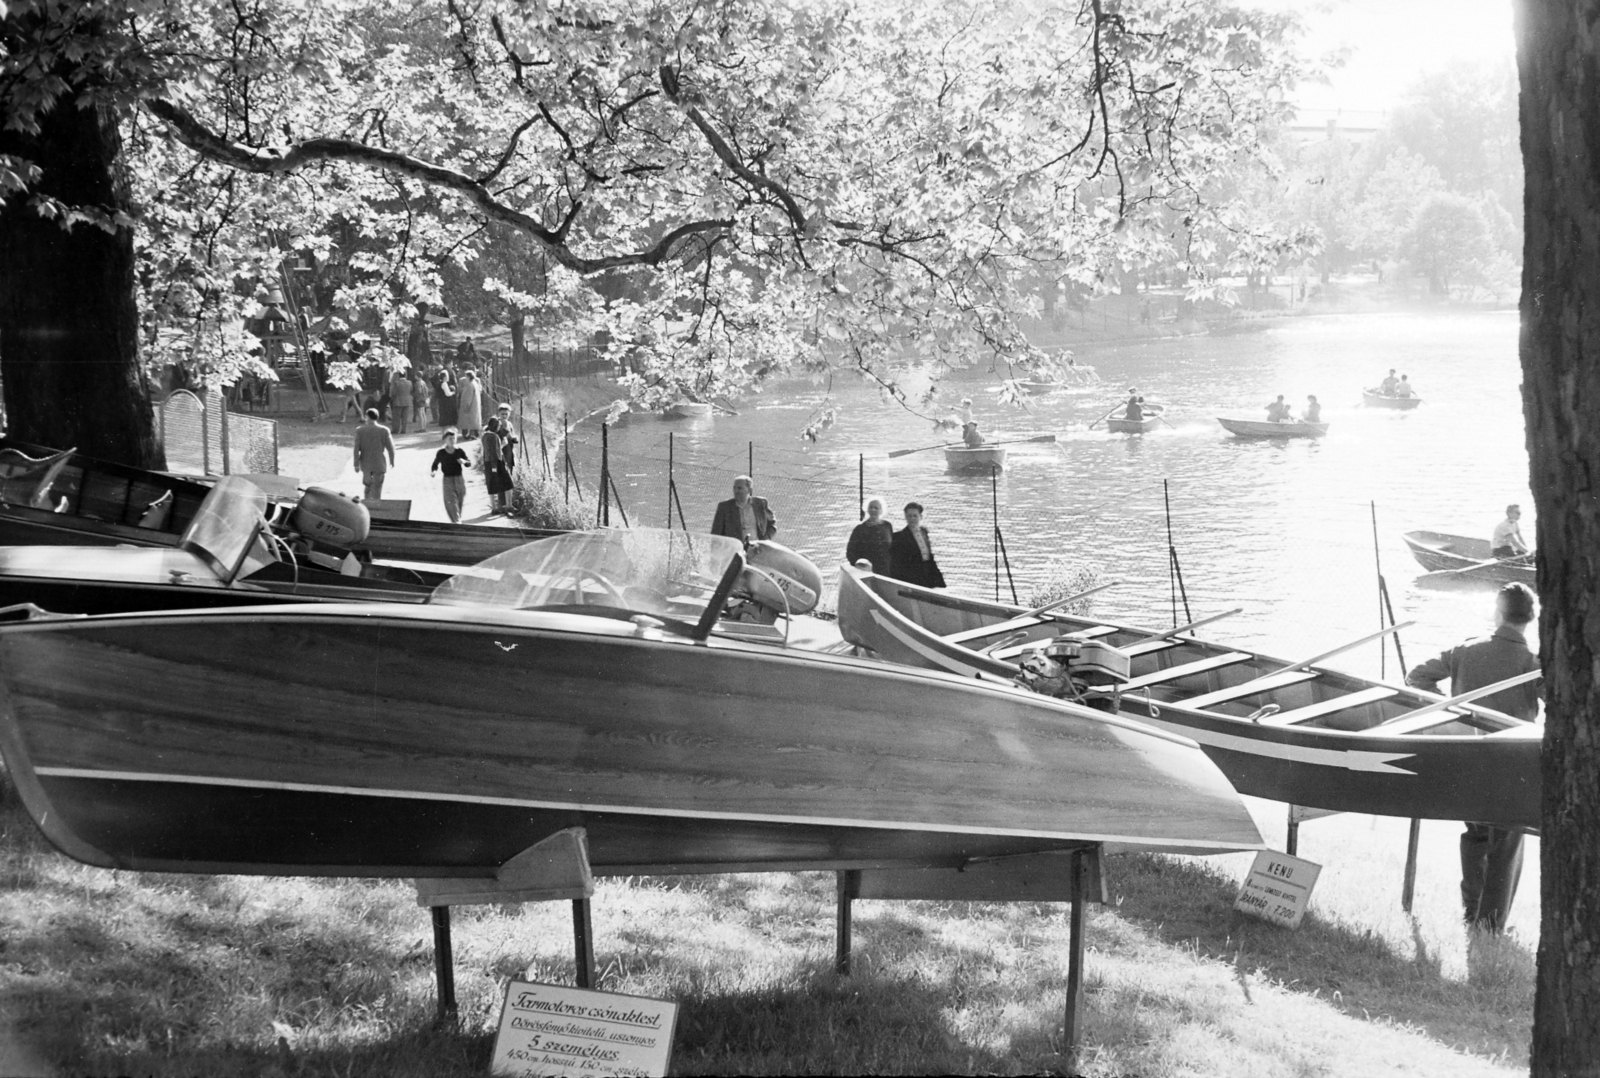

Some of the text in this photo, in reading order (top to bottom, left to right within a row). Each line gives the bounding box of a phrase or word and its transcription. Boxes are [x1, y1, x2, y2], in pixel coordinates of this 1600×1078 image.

[326, 525, 340, 535] 175
[777, 578, 791, 591] 175
[1267, 862, 1294, 878] KENU
[527, 1035, 541, 1048] 5
[580, 1060, 600, 1070] 150
